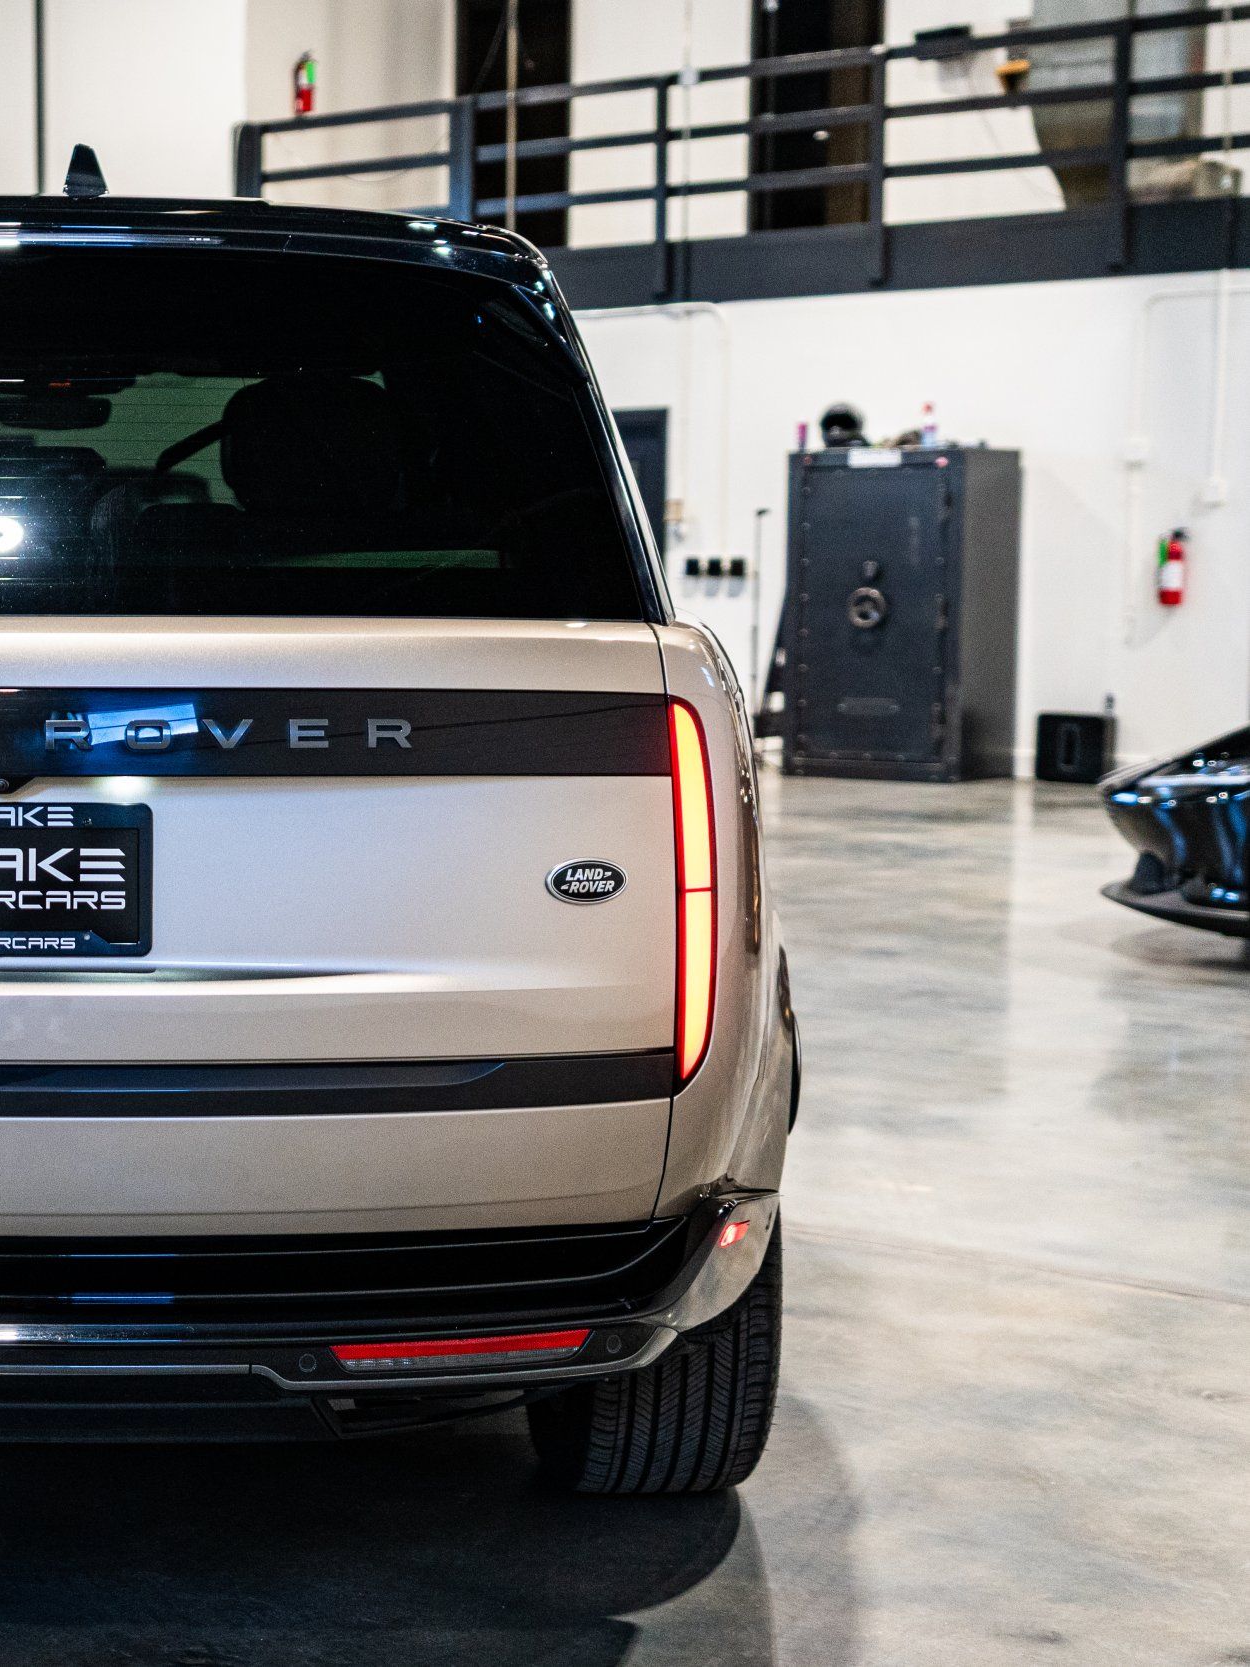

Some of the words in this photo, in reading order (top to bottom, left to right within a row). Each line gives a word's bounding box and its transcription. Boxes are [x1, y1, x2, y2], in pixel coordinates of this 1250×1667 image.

[45, 718, 413, 750] ROVER
[565, 868, 604, 881] LAND
[568, 880, 615, 894] ROVER
